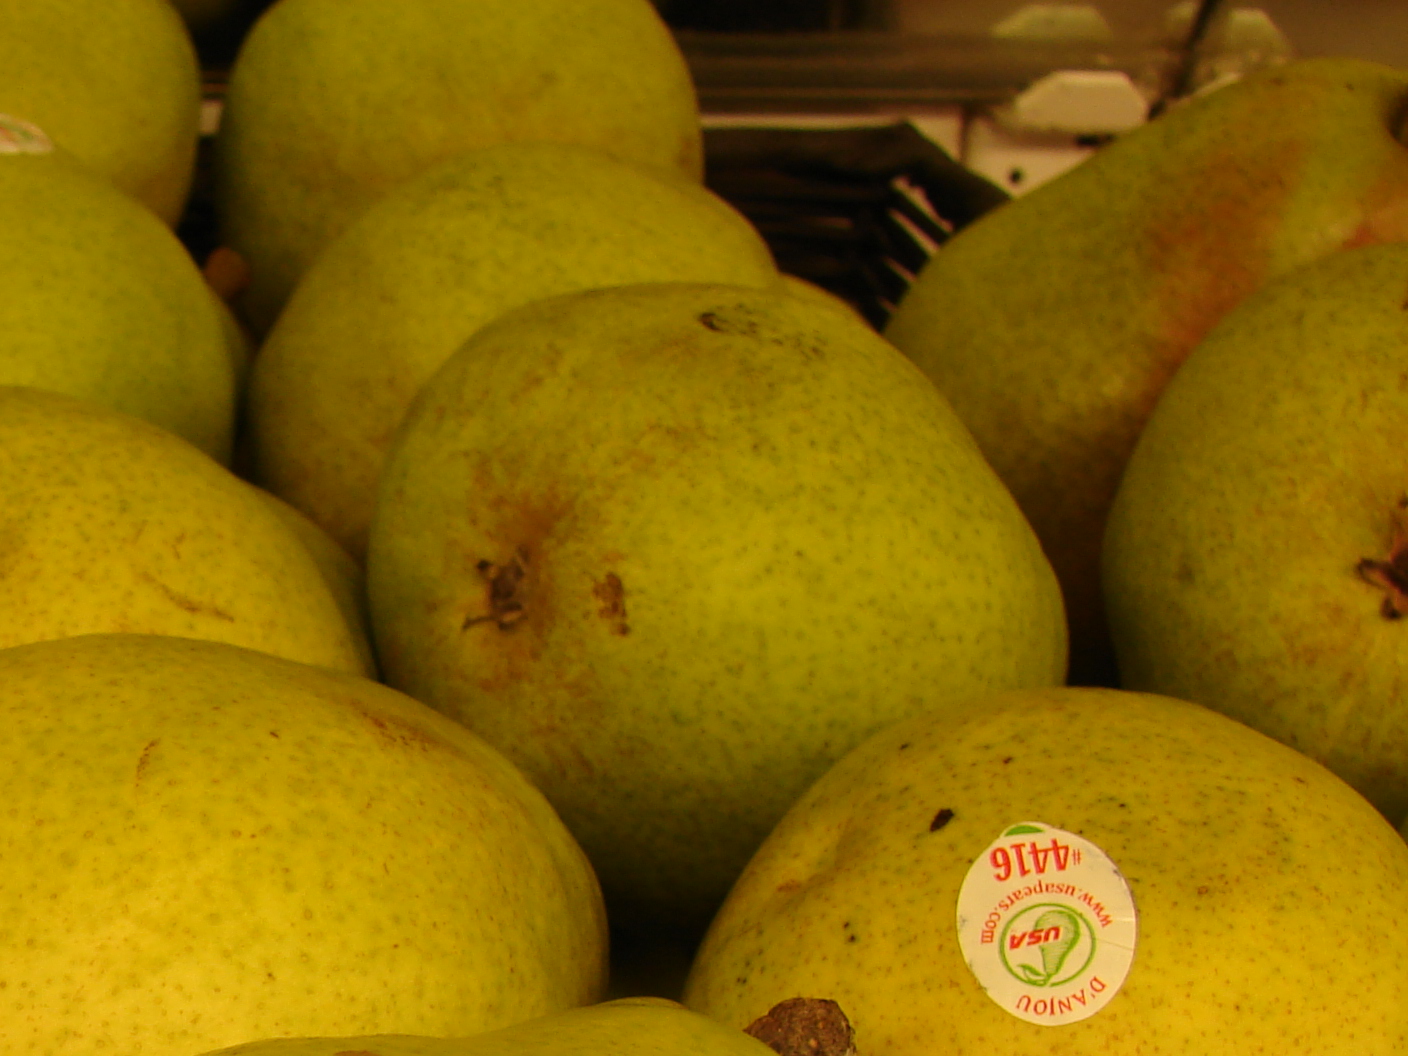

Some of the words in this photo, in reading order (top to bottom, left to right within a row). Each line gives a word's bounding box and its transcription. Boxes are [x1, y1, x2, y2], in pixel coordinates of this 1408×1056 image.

[990, 839, 1082, 881] #4416
[980, 880, 1112, 943] www.usapears.com
[1009, 926, 1061, 950] USA
[1015, 976, 1107, 1015] D'ANJOU
